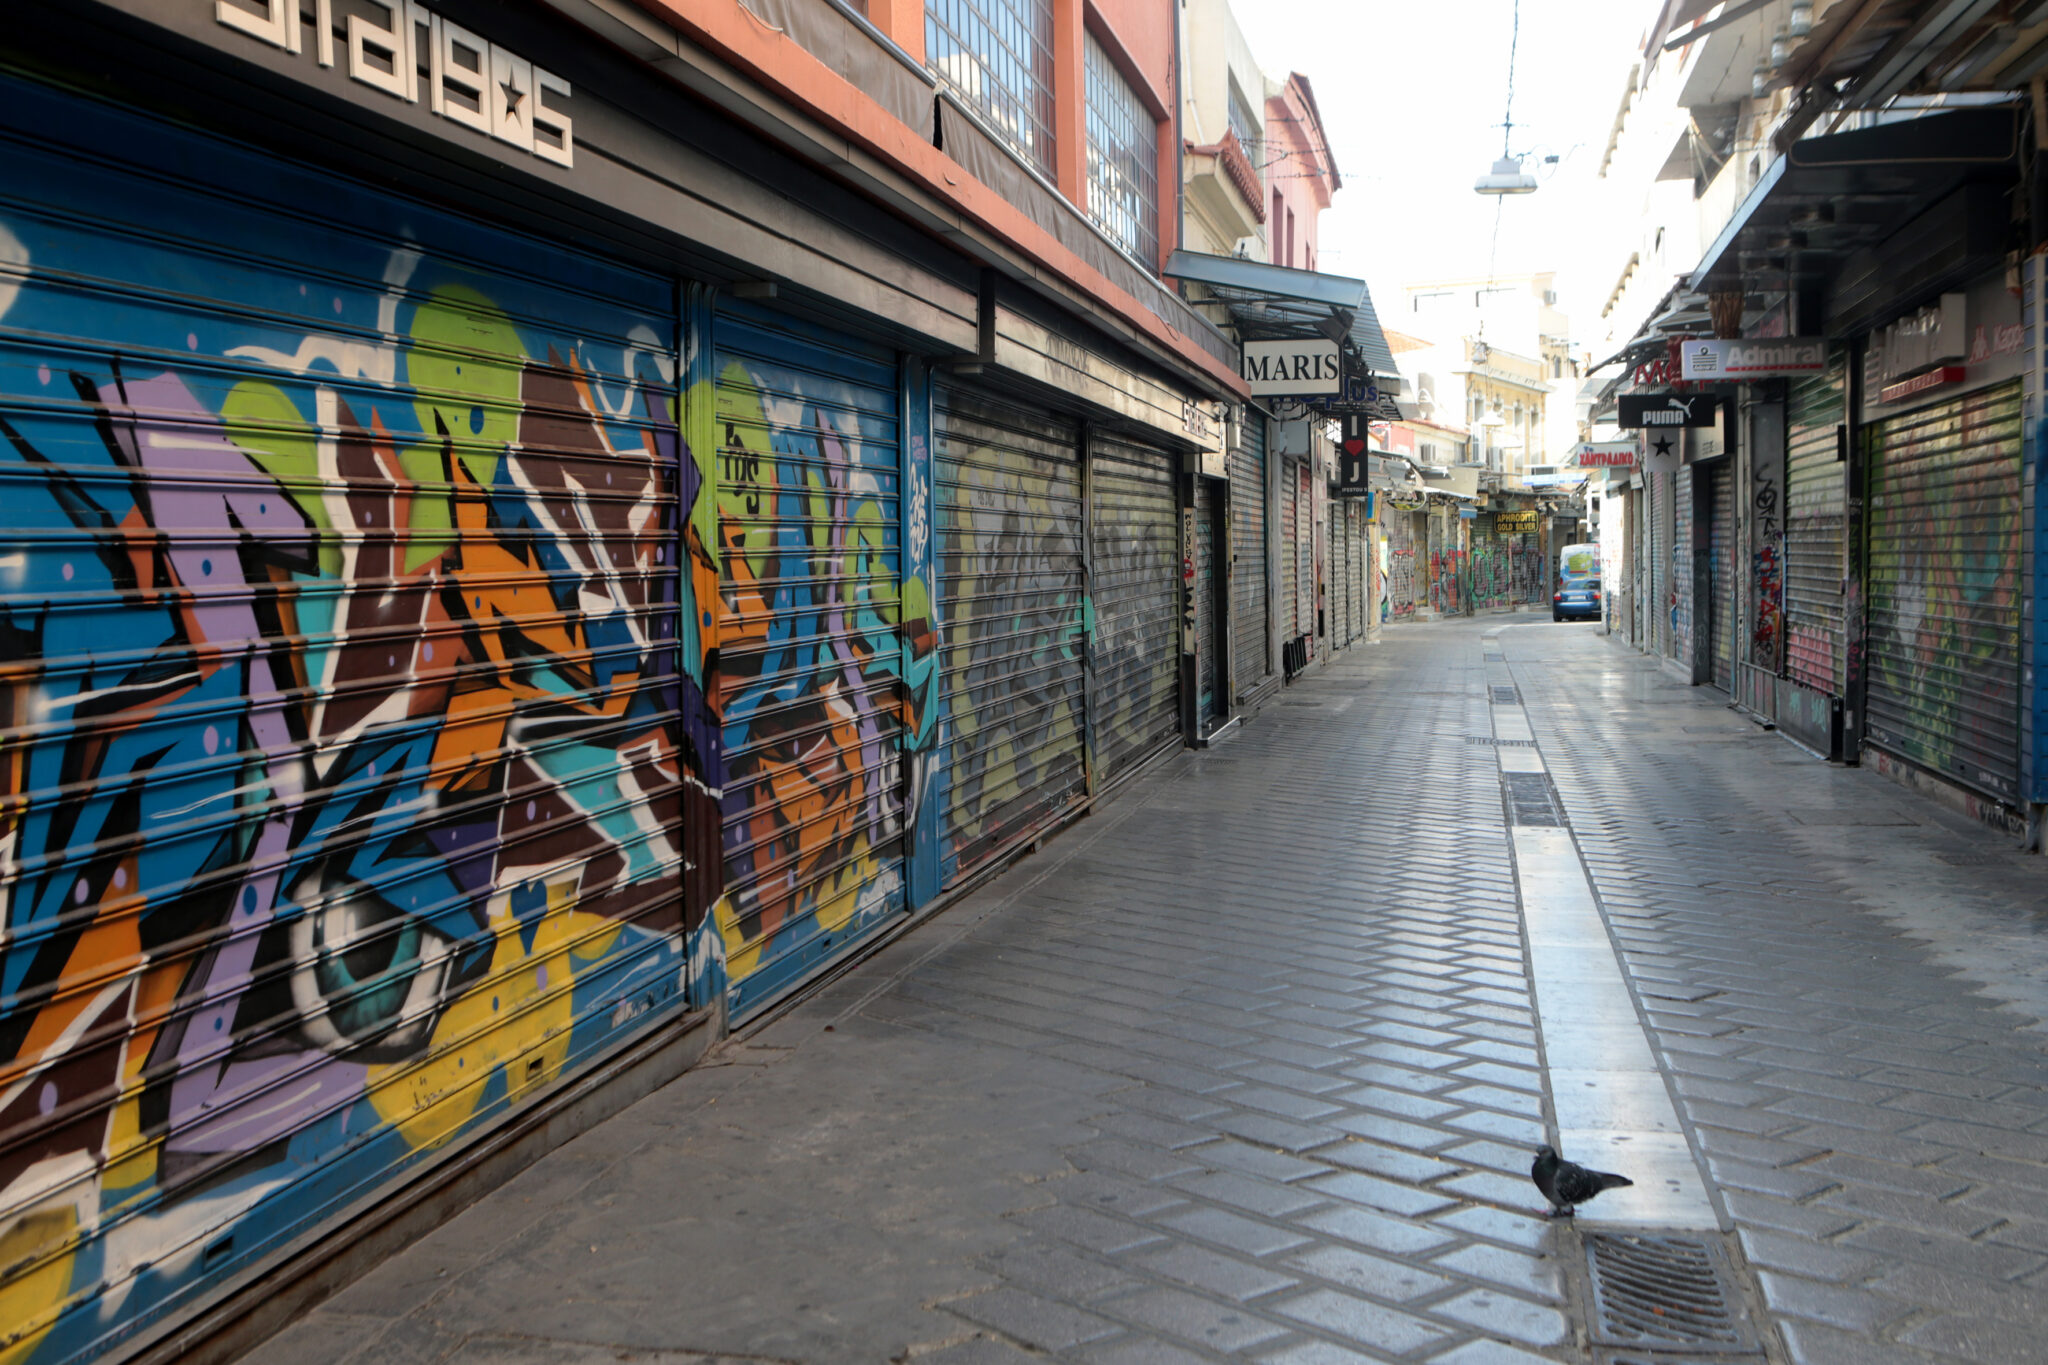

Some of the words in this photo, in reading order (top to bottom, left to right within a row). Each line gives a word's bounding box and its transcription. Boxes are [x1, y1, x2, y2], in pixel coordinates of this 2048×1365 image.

[1726, 342, 1824, 367] Admiral
[1246, 354, 1338, 382] MARIS
[1642, 410, 1684, 425] PUMA
[1496, 513, 1536, 522] APHRODITE
[1497, 523, 1513, 531] GOLD
[1516, 522, 1536, 531] SILVER
